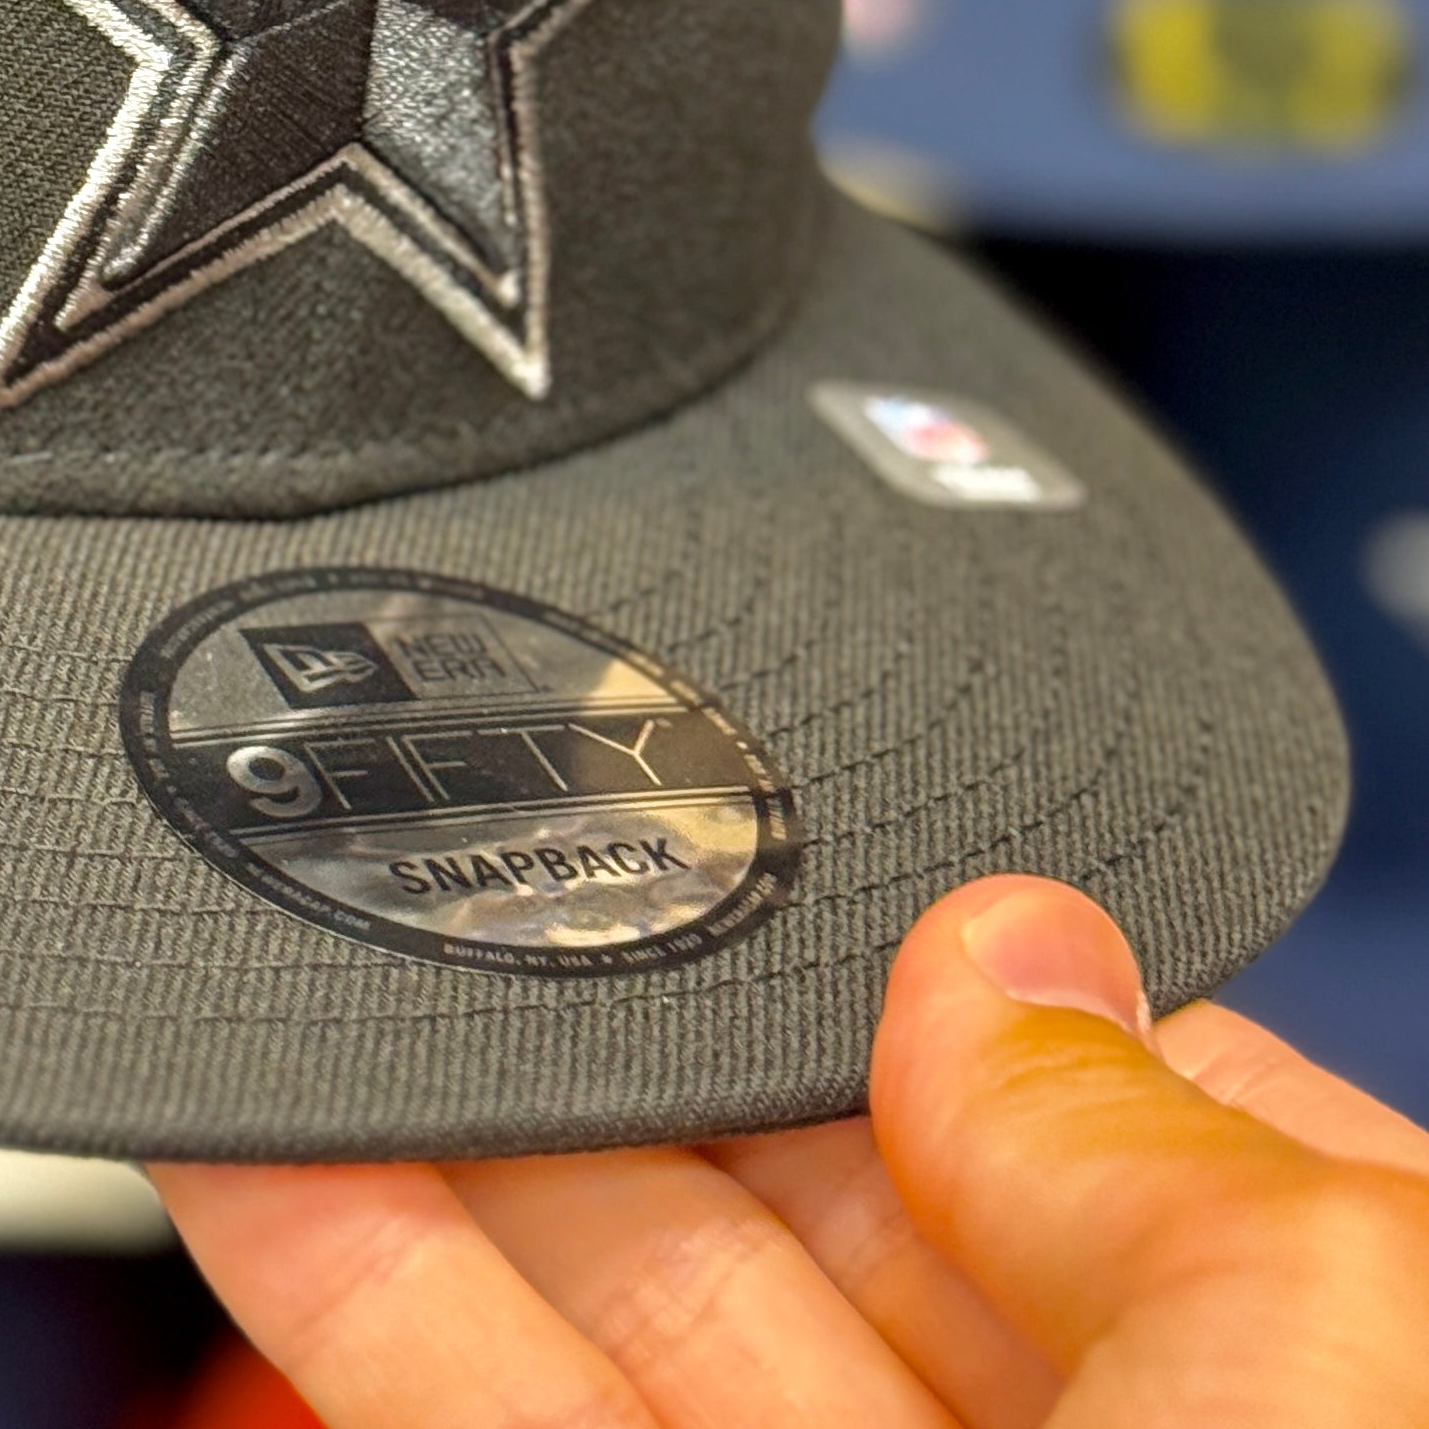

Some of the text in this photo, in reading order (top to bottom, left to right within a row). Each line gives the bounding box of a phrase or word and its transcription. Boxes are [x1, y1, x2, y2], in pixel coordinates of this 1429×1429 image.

[393, 632, 489, 658] NEW
[412, 656, 508, 682] ERA
[224, 718, 663, 818] 9FIFTY
[388, 836, 690, 895] SNAPBACK
